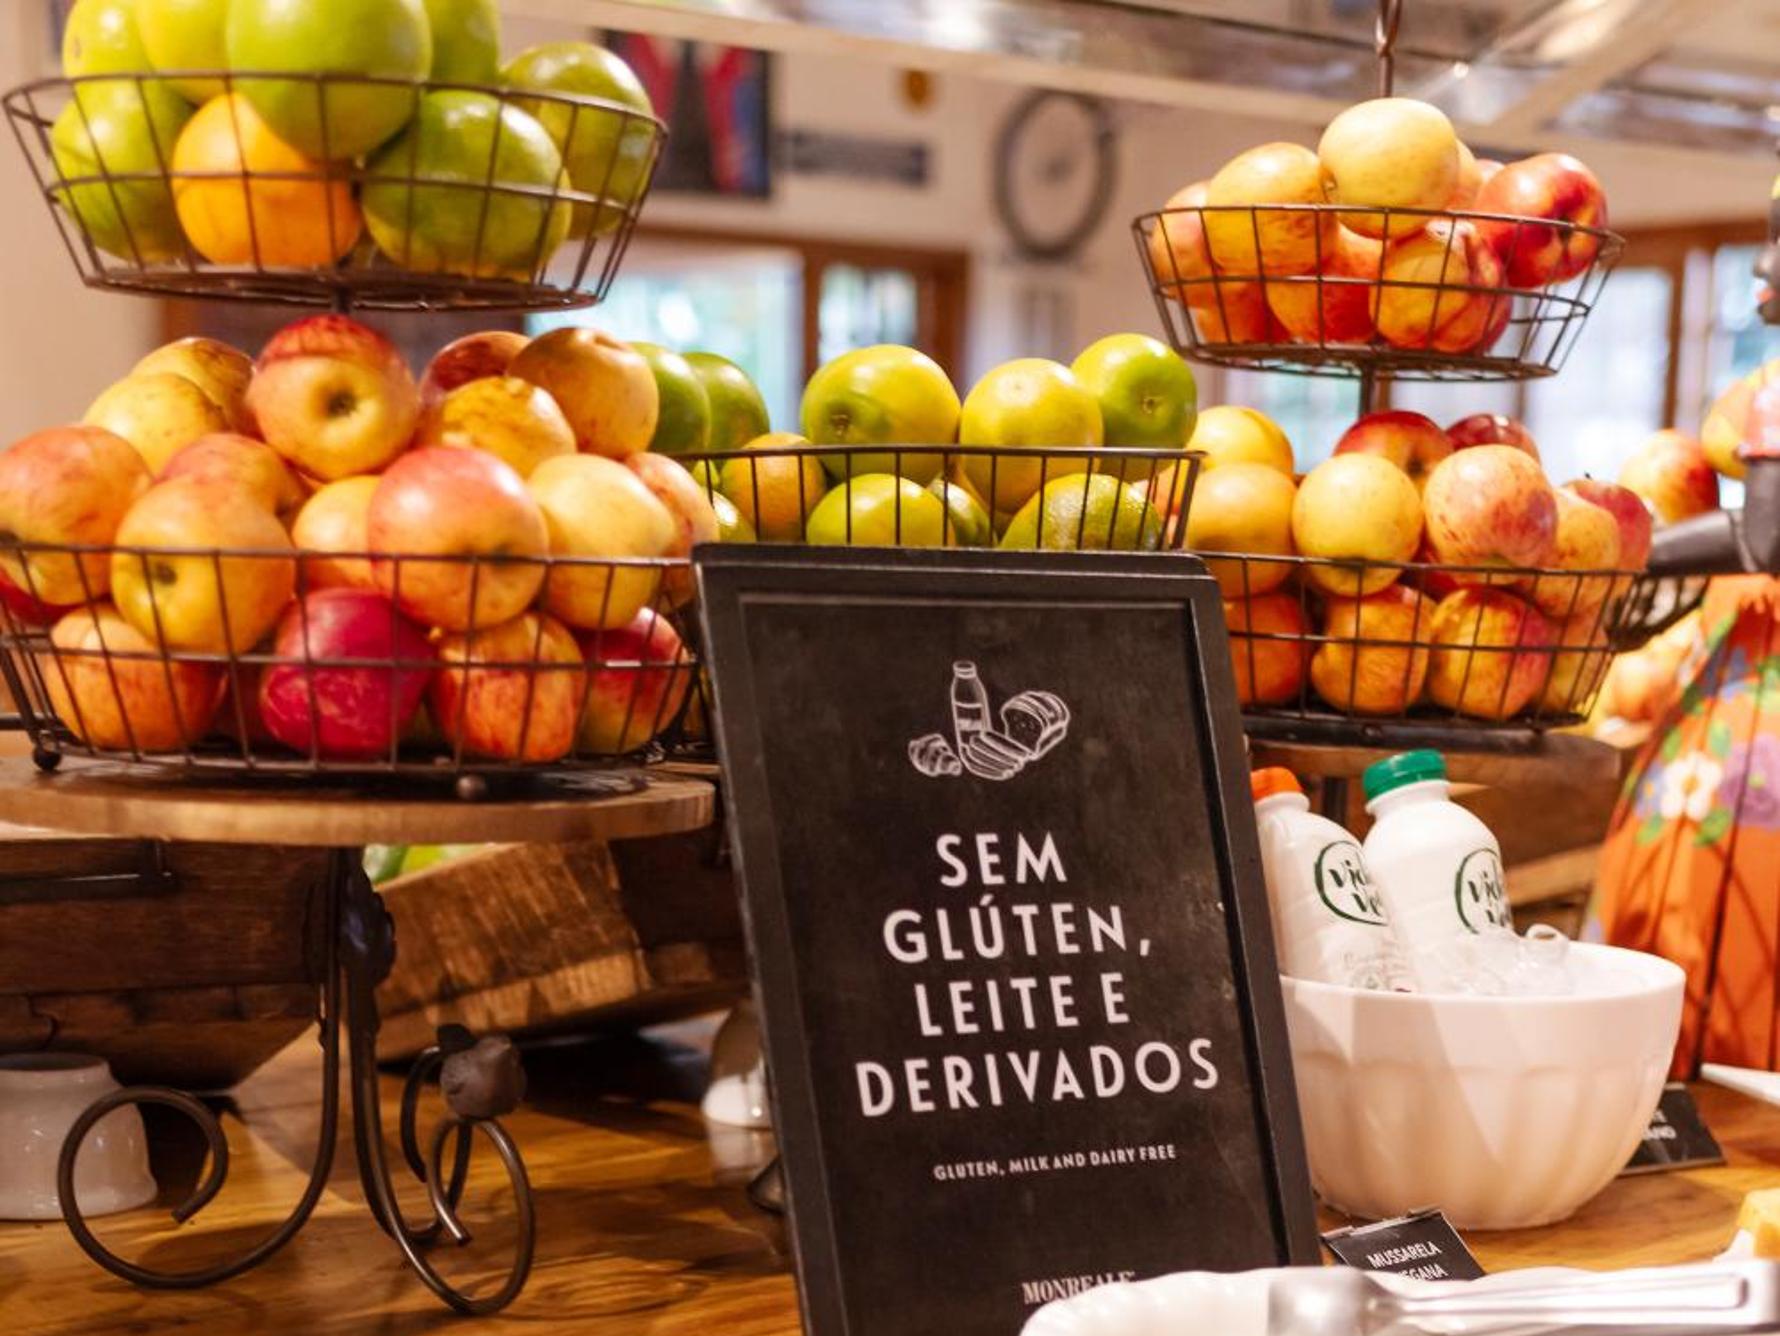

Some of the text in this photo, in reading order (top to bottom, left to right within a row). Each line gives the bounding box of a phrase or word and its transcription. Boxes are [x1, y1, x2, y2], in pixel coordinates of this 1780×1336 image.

[935, 830, 1068, 887] SEM
[882, 893, 1151, 964] GLÚTEN,
[914, 972, 1130, 1036] LEITE E
[855, 1037, 1219, 1117] DERIVADOS
[933, 1144, 1177, 1181] GLUTEN, MILK AND DAIRY FREE
[1366, 1240, 1443, 1269] MUSSARELA
[1399, 1262, 1449, 1281] GANA
